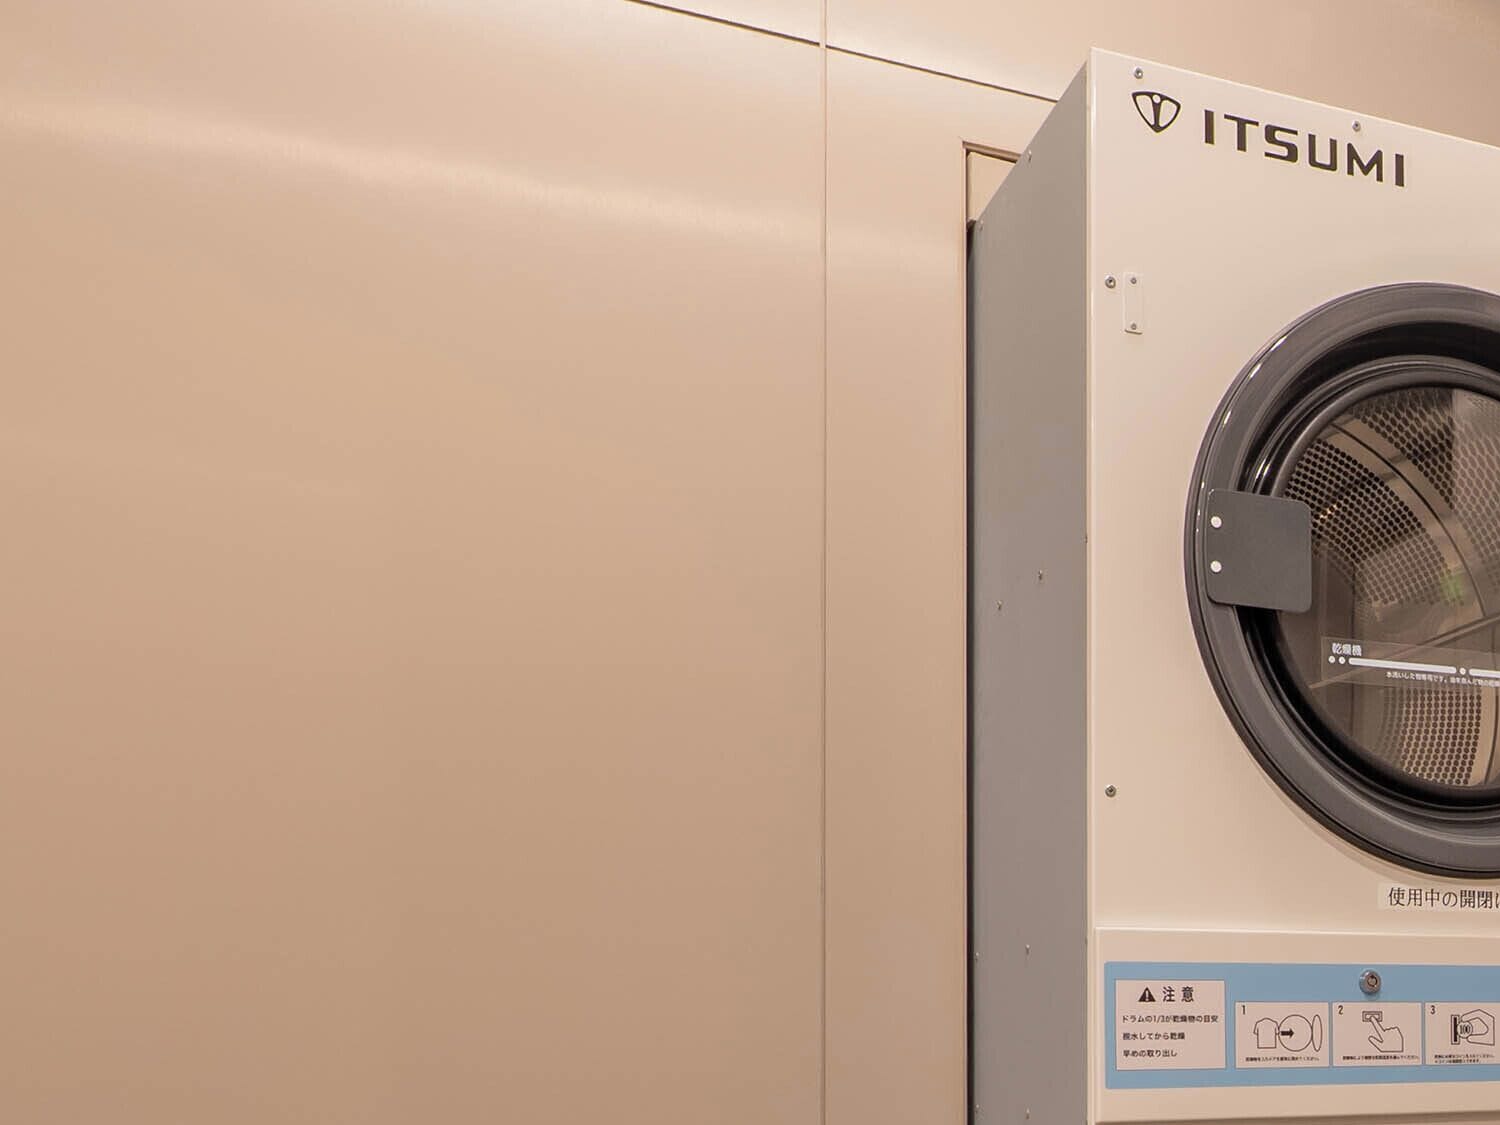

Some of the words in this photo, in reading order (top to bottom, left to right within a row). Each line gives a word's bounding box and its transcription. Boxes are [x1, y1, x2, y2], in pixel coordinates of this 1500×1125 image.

[1204, 109, 1405, 188] ITSUMI
[1162, 986, 1194, 1003] 注意
[1242, 1005, 1246, 1015] 1
[1338, 1005, 1344, 1016] 2
[1430, 1005, 1436, 1015] 3
[1122, 1032, 1186, 1041] 脱水してから乾燥
[1123, 1049, 1178, 1058] 早めの取り出し
